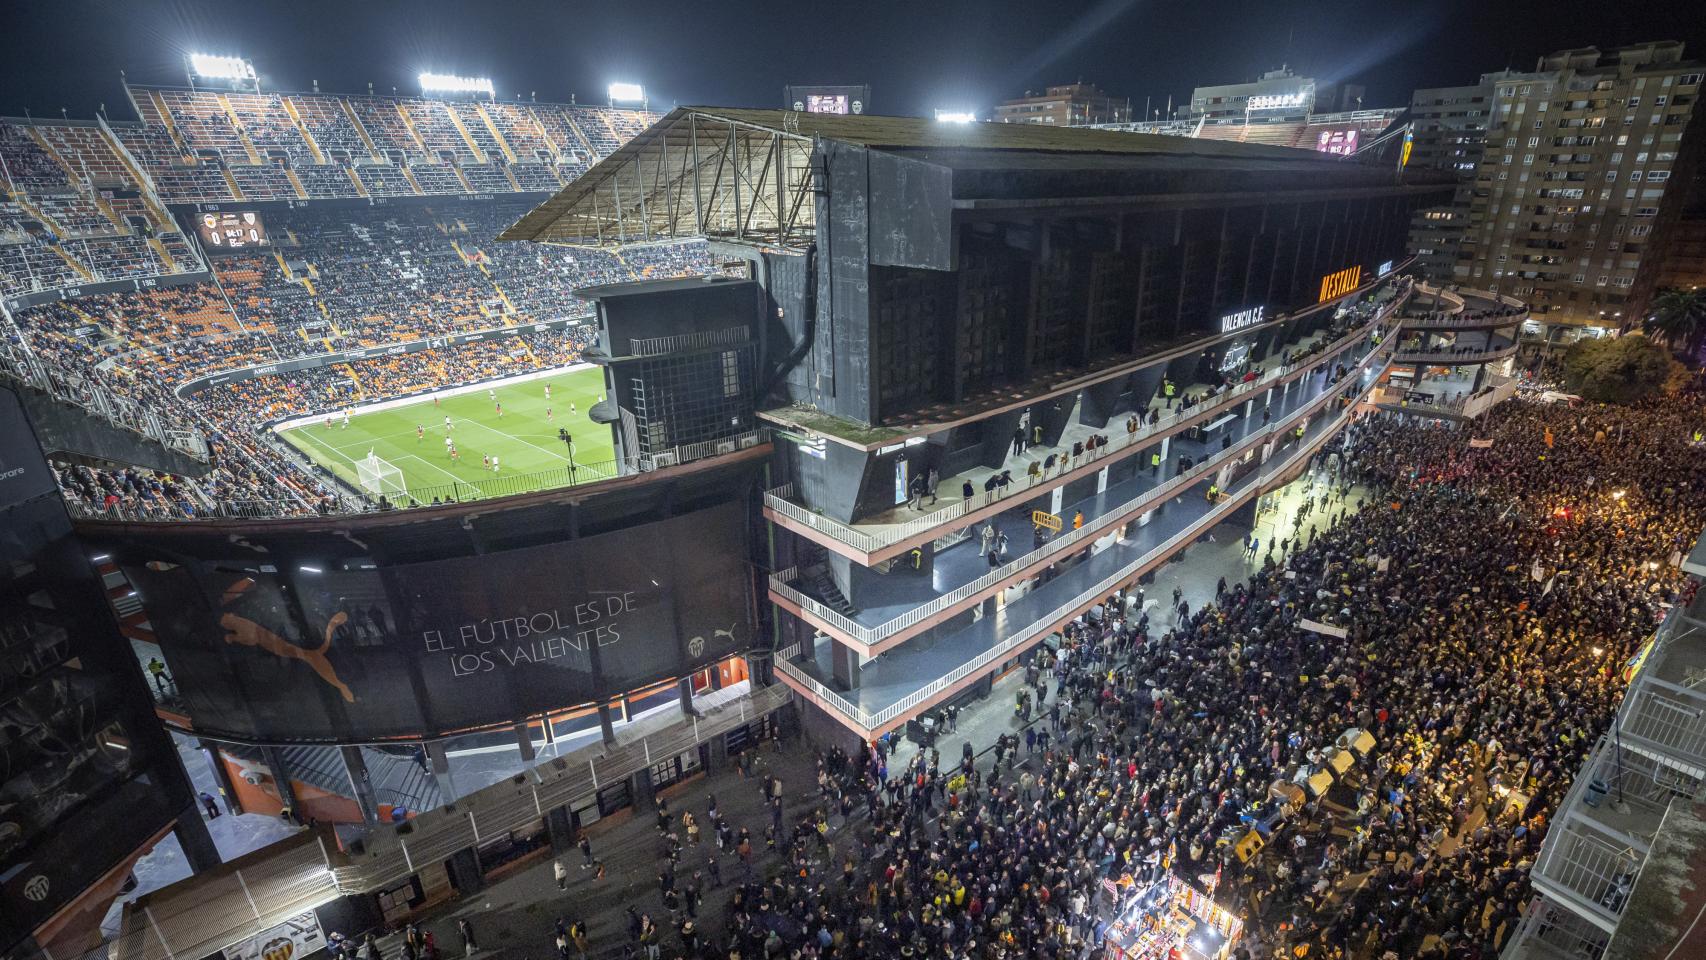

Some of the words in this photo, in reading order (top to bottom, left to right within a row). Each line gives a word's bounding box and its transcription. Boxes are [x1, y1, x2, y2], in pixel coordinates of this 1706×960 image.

[1319, 264, 1361, 303] MESTALLA
[1221, 309, 1252, 333] VALENCIA
[253, 365, 278, 375] AMSTEL
[423, 630, 455, 652] EL
[460, 609, 570, 648] FÚTBOL
[575, 601, 601, 625] ES
[607, 591, 637, 617] DE
[450, 650, 495, 677] LOS
[500, 622, 621, 667] VALIENTES
